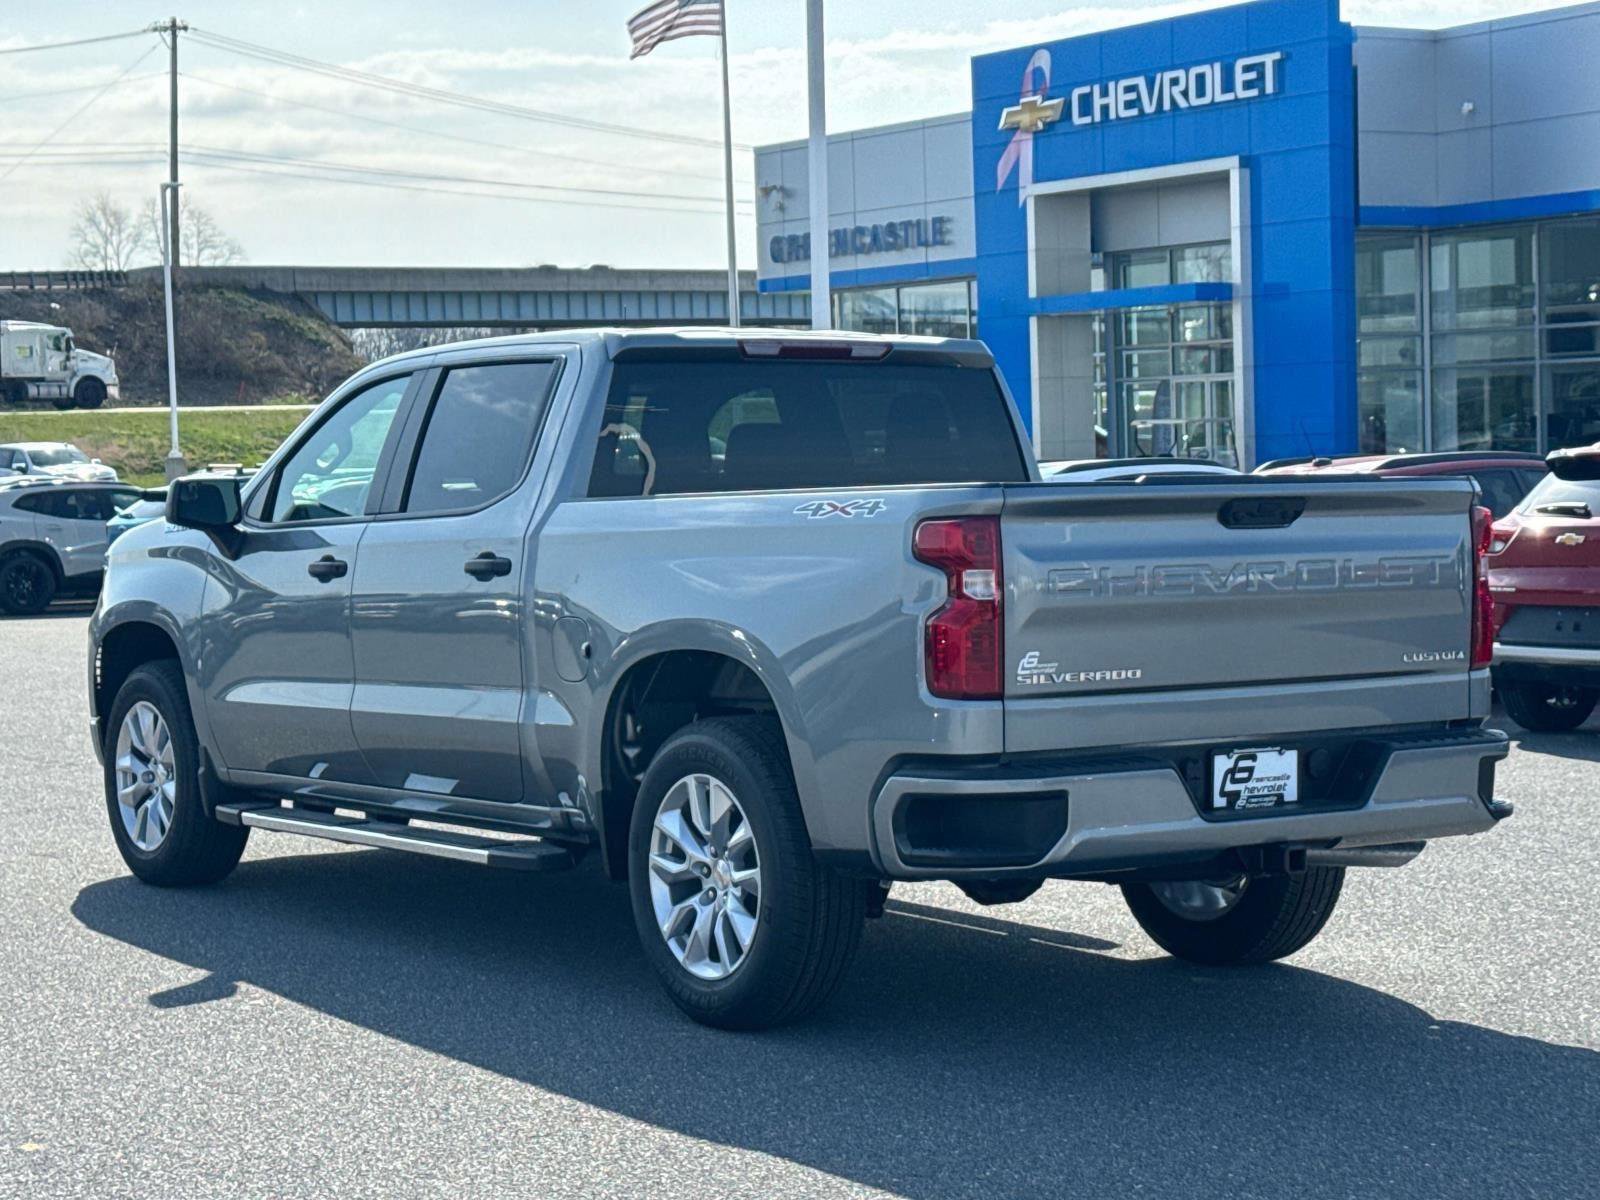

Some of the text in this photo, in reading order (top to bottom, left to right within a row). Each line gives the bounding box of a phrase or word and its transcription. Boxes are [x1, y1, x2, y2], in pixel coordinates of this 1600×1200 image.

[1071, 51, 1283, 126] CHEVROLET
[769, 215, 953, 264] GRENCASTLE
[1047, 555, 1452, 597] CHEVROLET
[1017, 669, 1141, 685] SILVERADO
